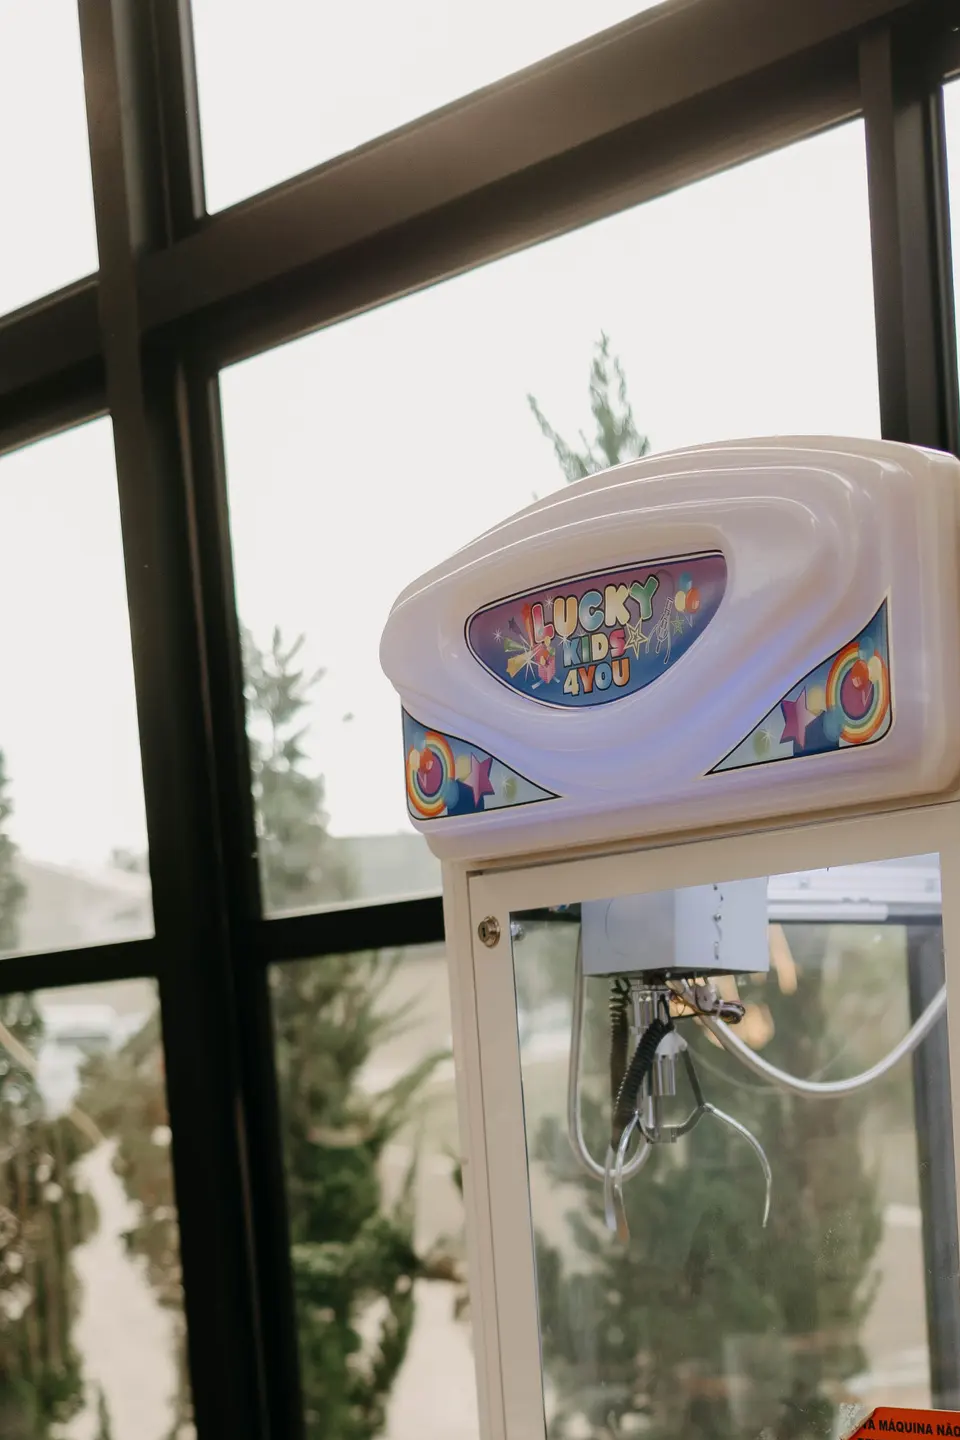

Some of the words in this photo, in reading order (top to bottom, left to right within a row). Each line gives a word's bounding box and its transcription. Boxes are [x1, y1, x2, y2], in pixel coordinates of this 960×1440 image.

[531, 573, 660, 645] LUCKY
[562, 628, 626, 669] KIDS
[562, 657, 631, 697] 4YOU
[878, 1418, 933, 1436] MÁQUINA
